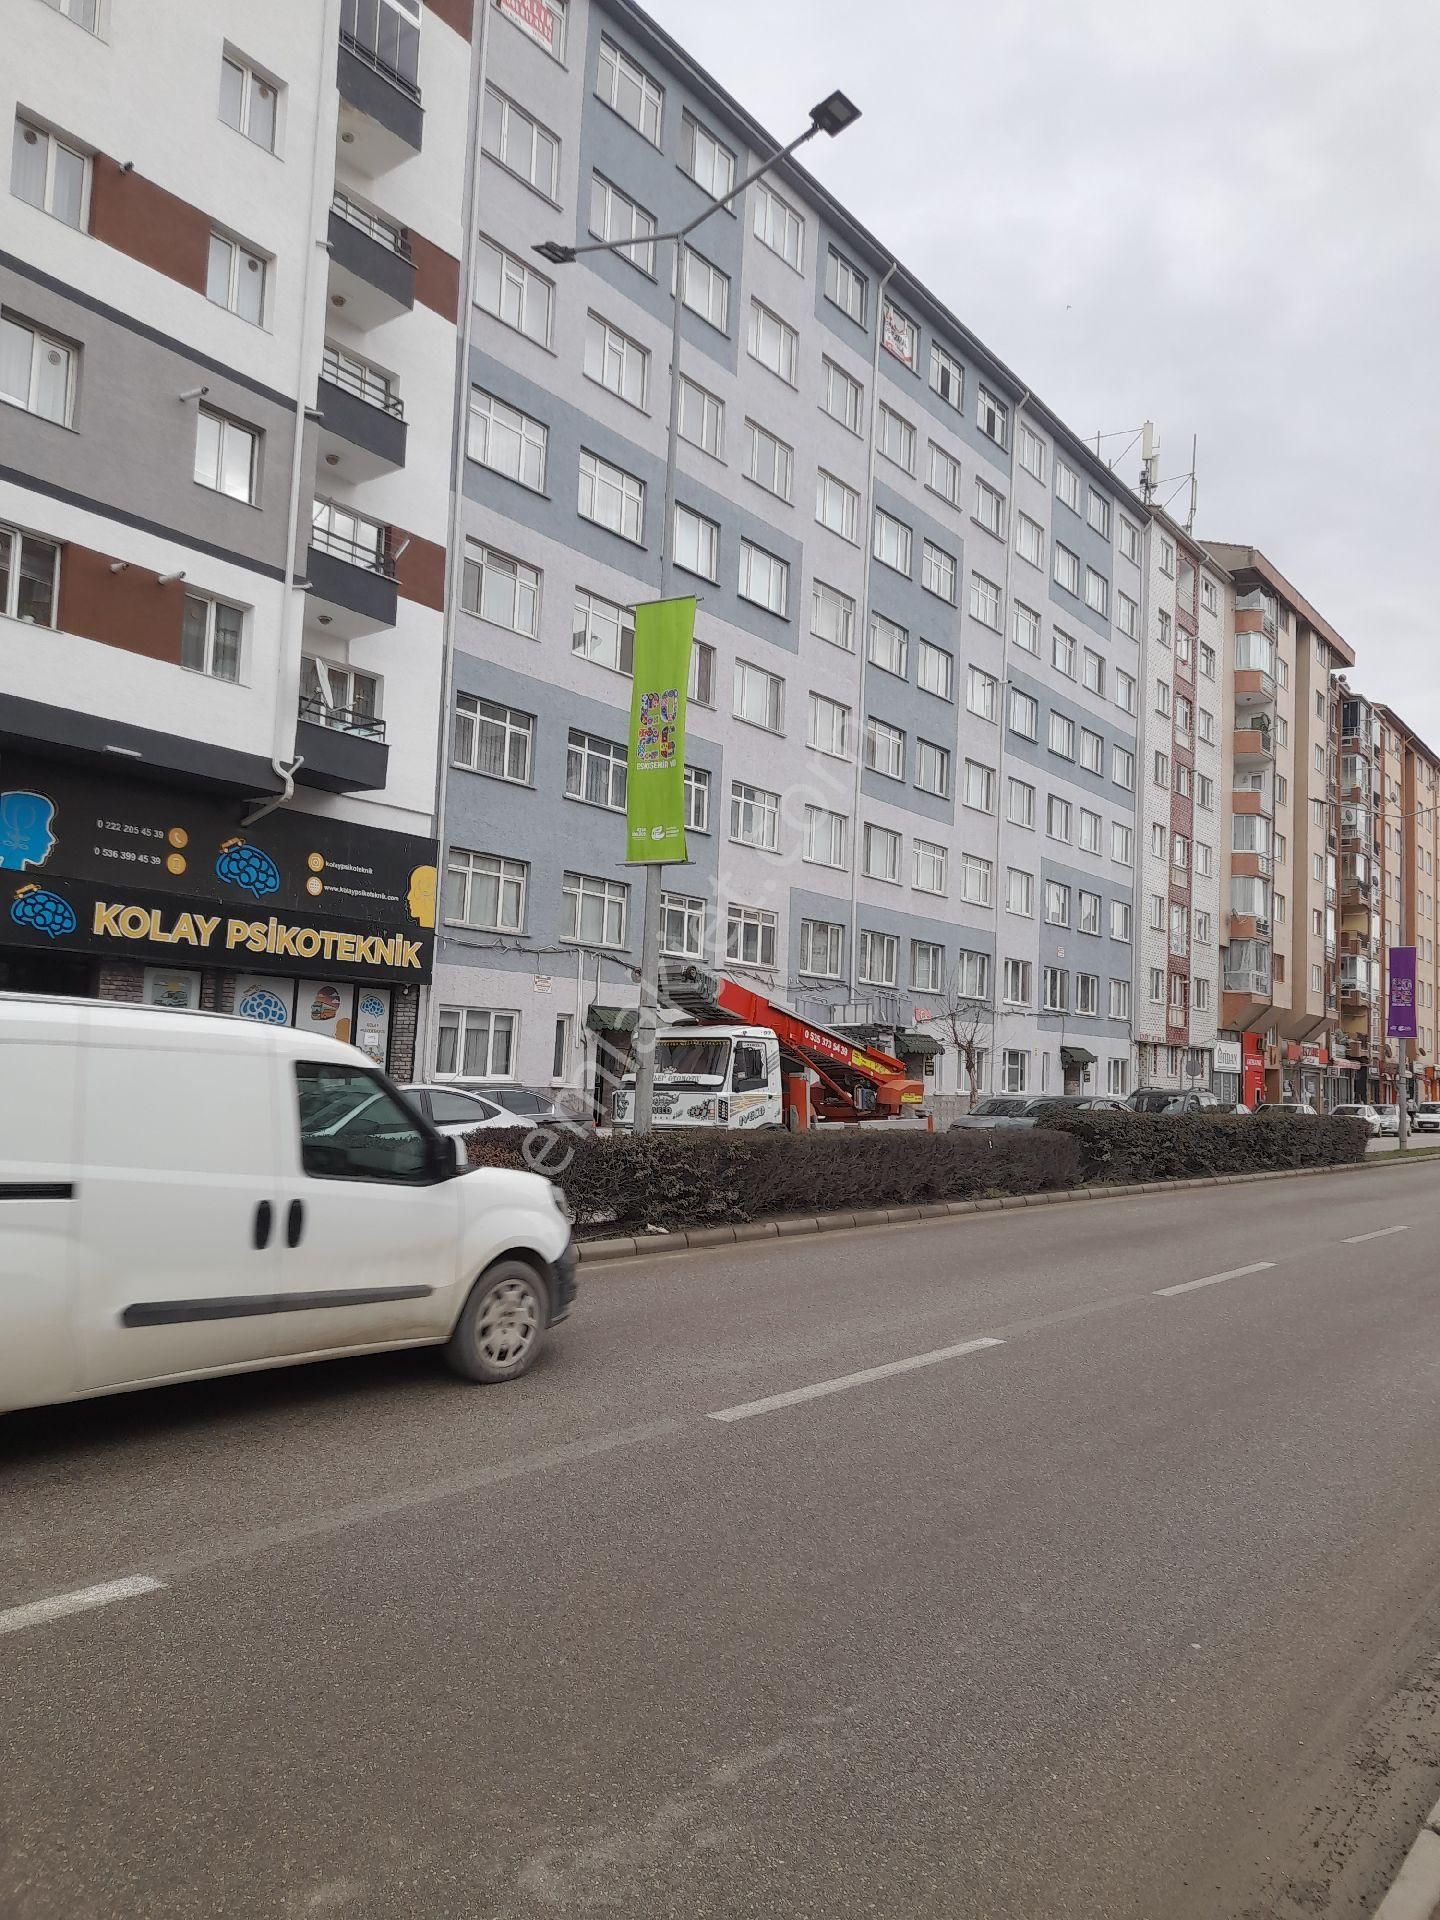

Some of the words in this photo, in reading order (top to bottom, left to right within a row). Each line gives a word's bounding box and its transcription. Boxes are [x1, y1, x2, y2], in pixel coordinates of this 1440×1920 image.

[105, 821, 122, 832] 222
[123, 824, 140, 835] 205
[141, 827, 152, 837] 45
[153, 830, 164, 839] 39
[94, 846, 100, 855] 0
[102, 848, 119, 859] 536
[120, 851, 137, 861] 399
[137, 854, 149, 863] 45
[150, 856, 161, 865] 39
[93, 901, 221, 947] KOLAY
[226, 916, 423, 969] PSİKOTEKNİK
